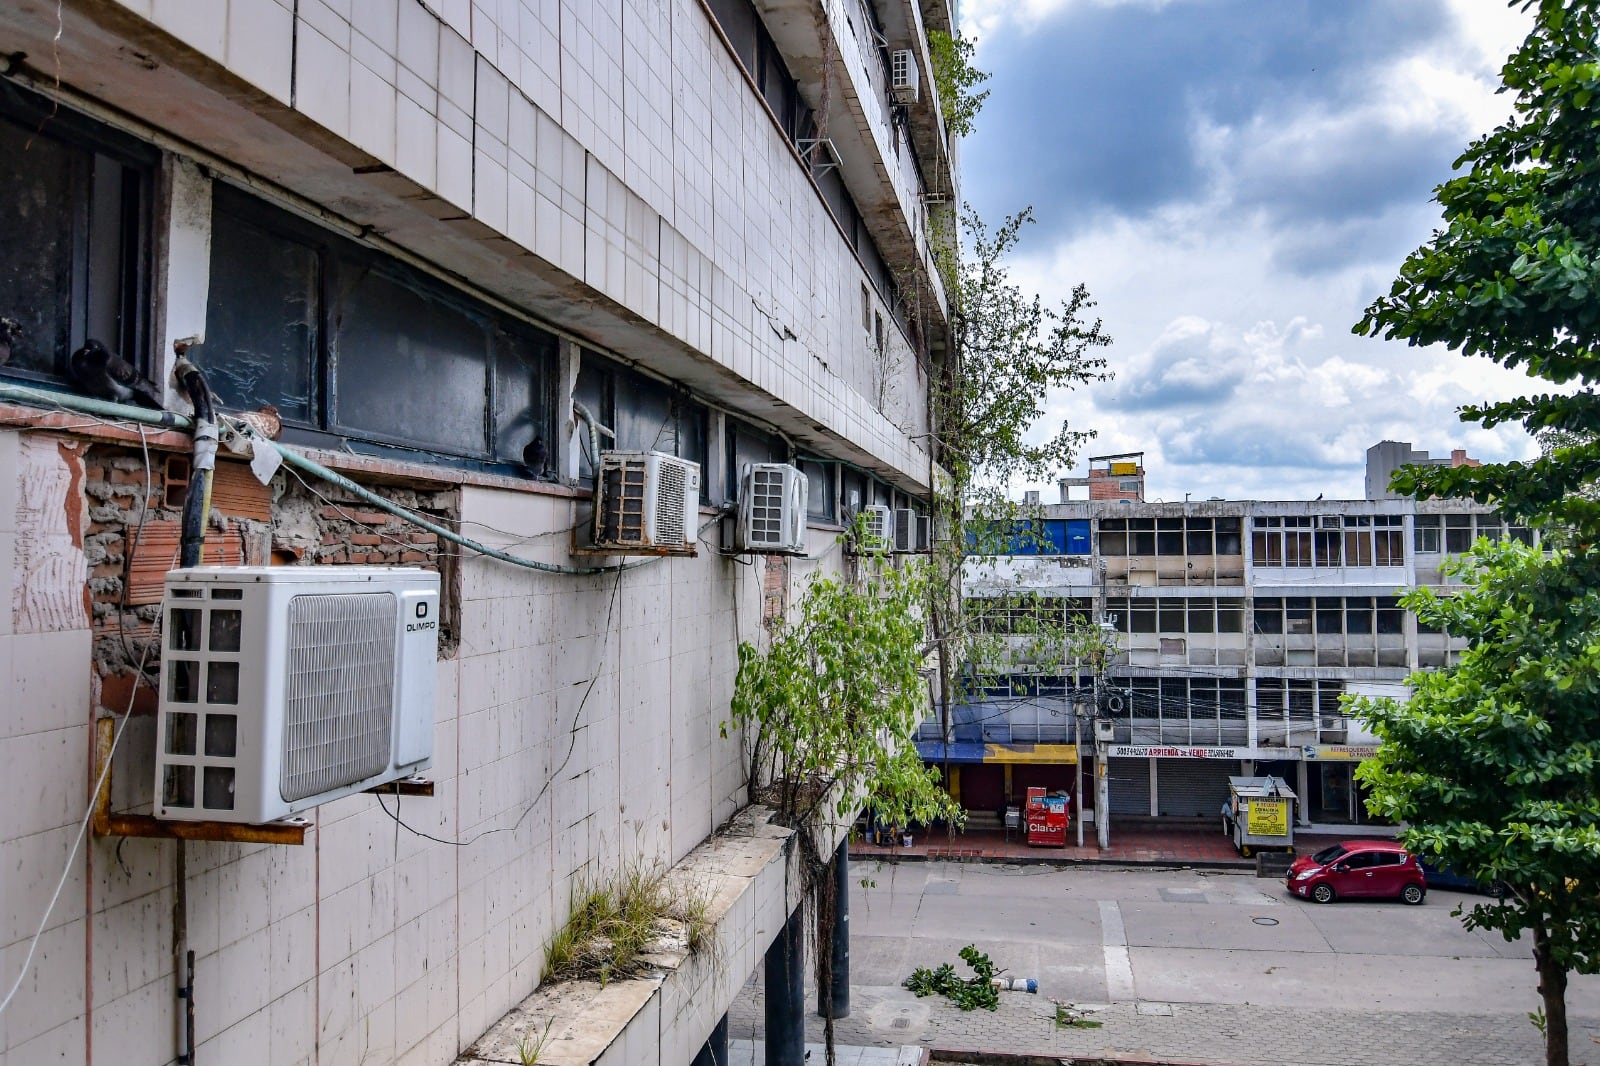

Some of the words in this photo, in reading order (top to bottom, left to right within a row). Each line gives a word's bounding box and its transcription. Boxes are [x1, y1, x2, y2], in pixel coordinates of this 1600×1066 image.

[407, 622, 435, 632] OLIMPO
[1148, 748, 1179, 757] ARRIENDA
[1189, 749, 1208, 758] VENDE
[1029, 823, 1057, 833] Claro
